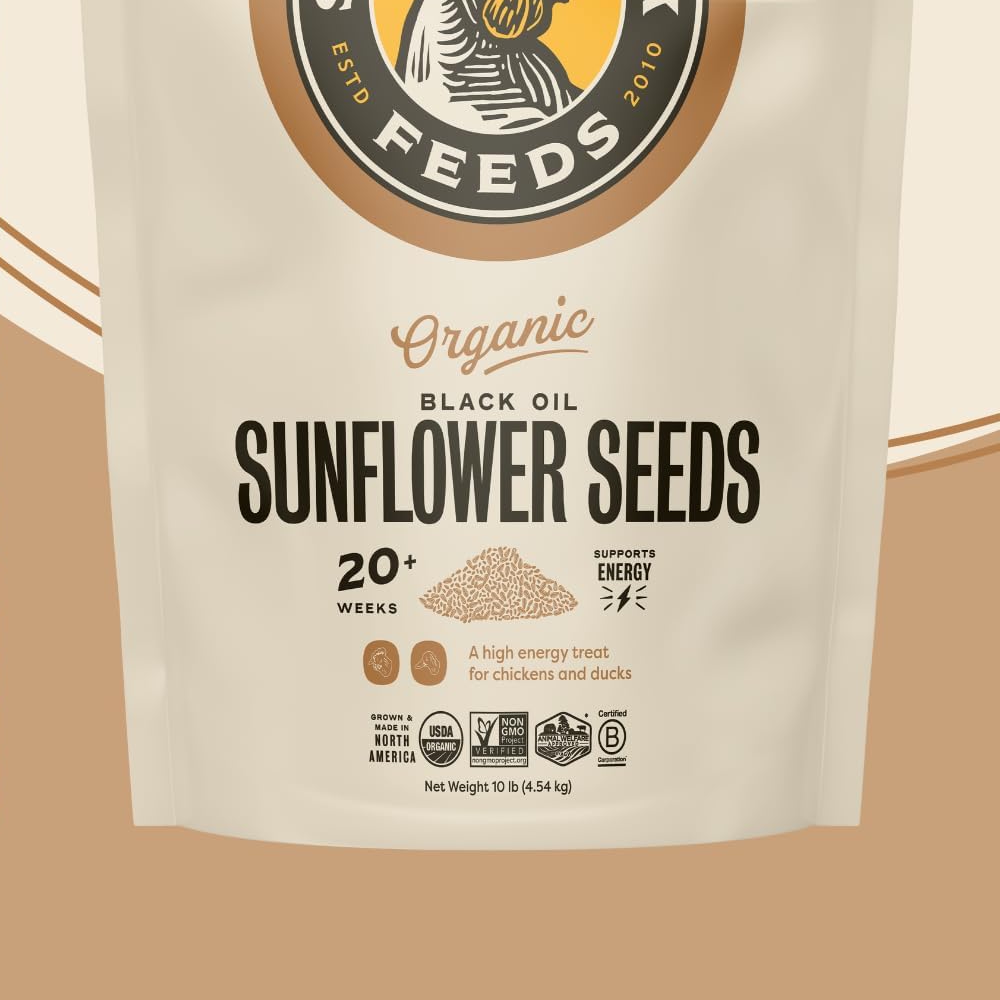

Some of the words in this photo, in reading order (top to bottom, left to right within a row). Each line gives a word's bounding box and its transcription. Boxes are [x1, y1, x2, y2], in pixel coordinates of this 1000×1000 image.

[332, 41, 371, 105] ESTD
[623, 42, 662, 107] 2010
[372, 110, 620, 195] FEEDS
[391, 295, 595, 374] Organic
[420, 392, 515, 411] BLACK
[532, 392, 578, 411] OIL
[234, 419, 568, 525] SUNFLOWER
[587, 419, 761, 525] SEEDS
[593, 549, 656, 559] SUPPORTS
[597, 562, 652, 582] ENERGY
[336, 602, 398, 615] WEEKS
[468, 646, 480, 660] A
[482, 645, 514, 662] high
[517, 648, 568, 662] energy
[571, 645, 610, 659] treat
[468, 666, 489, 681] for
[492, 666, 555, 680] chickens
[558, 666, 587, 680] and
[590, 665, 632, 680] ducks
[370, 713, 403, 721] GROWN
[598, 709, 628, 718] Certified
[374, 723, 398, 731] MADE
[501, 717, 524, 727] NON
[429, 725, 454, 737] USDA
[501, 726, 525, 736] GMO
[605, 726, 620, 748] B
[374, 733, 410, 747] NORTH
[425, 741, 457, 751] ORGANIC
[501, 735, 524, 745] Project
[368, 749, 416, 763] AMERICA
[475, 747, 524, 755] VERIFIED
[424, 780, 446, 793] Net
[447, 780, 490, 796] Weight
[491, 781, 505, 793] 10
[507, 780, 519, 793] lb
[521, 780, 552, 796] (4.54
[554, 780, 573, 796] kg)
